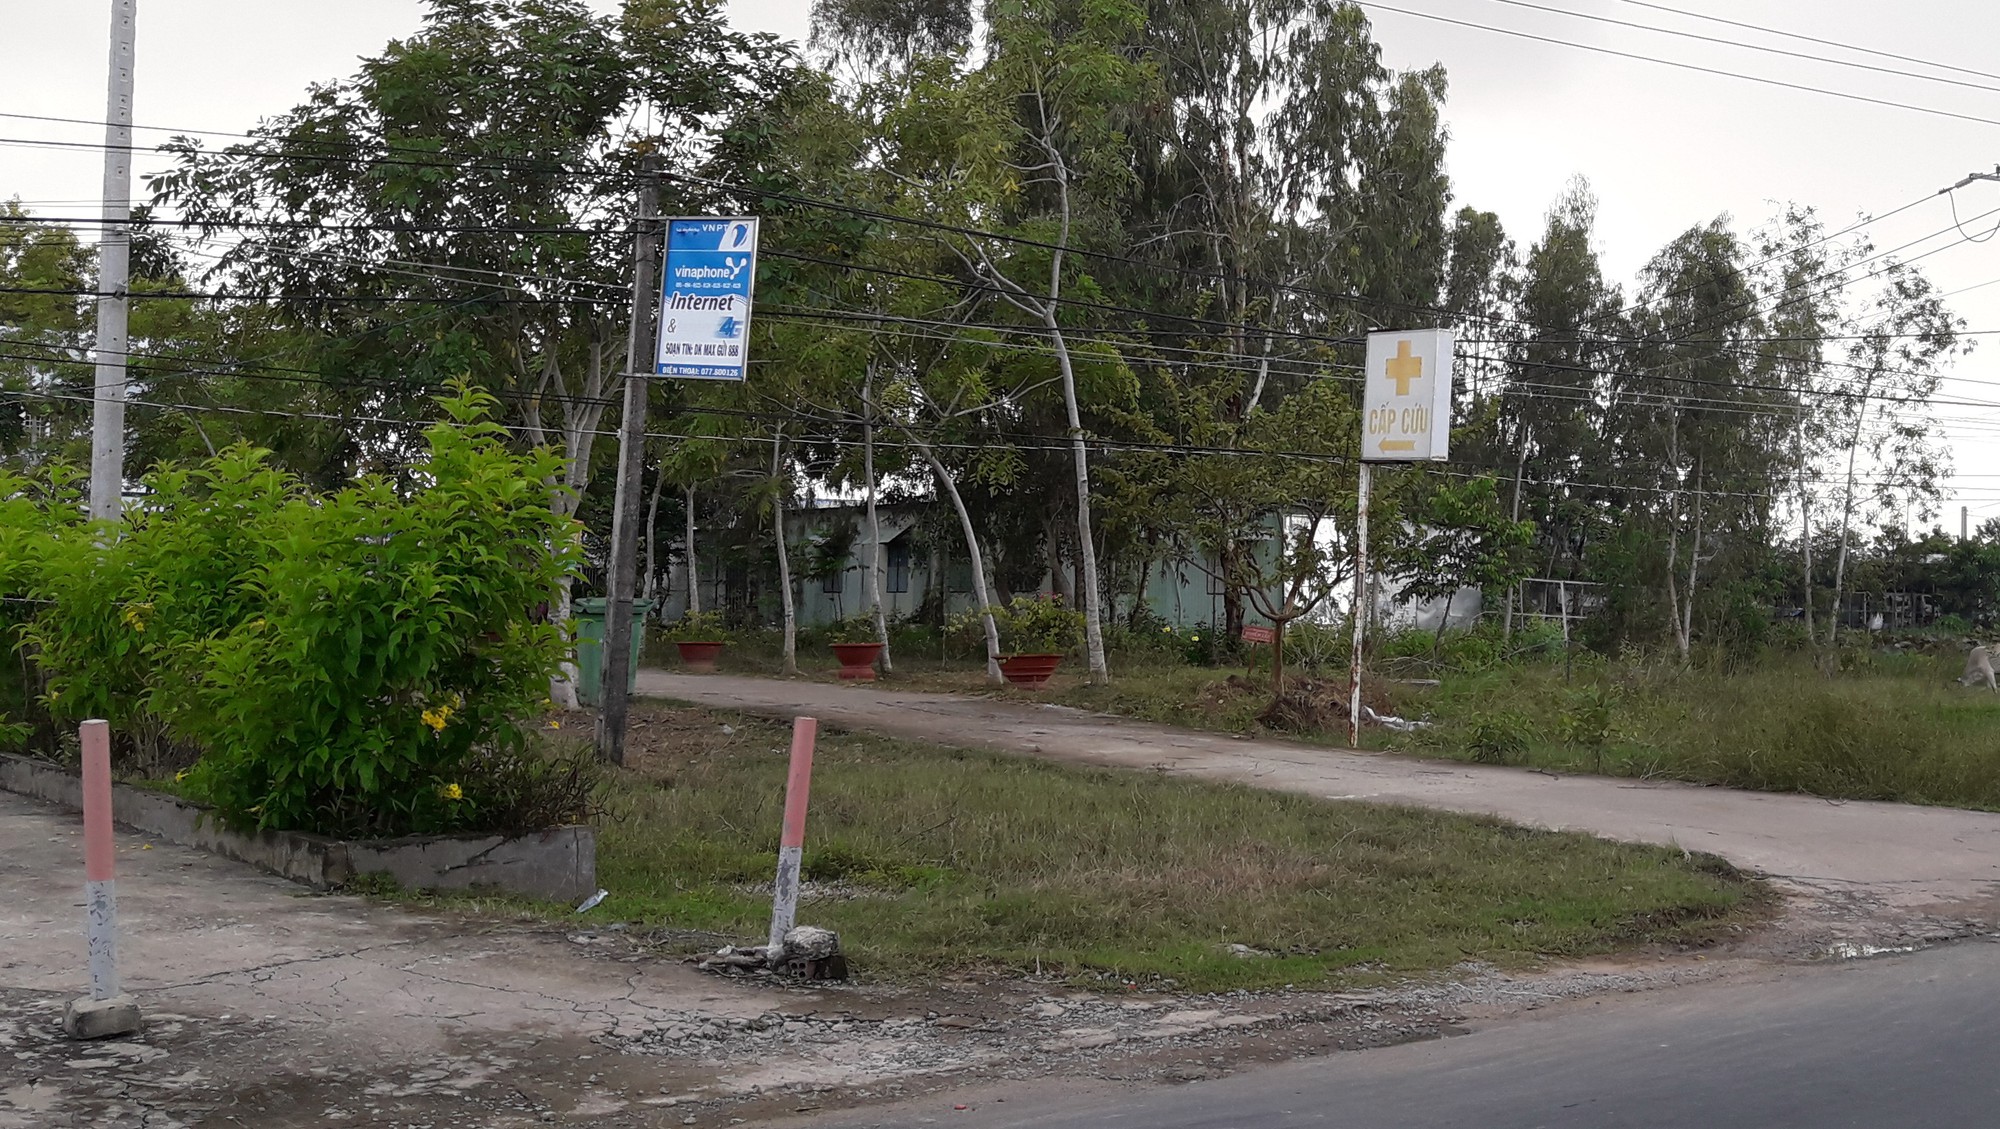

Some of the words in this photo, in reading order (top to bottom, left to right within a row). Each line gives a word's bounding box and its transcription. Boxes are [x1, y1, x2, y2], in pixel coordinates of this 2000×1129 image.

[702, 224, 728, 232] VNPT
[675, 265, 730, 279] vinaphone
[670, 293, 734, 310] Internet
[667, 318, 676, 333] &
[703, 344, 716, 356] MAX
[1369, 402, 1396, 434] CẤP
[1401, 402, 1429, 434] CỨU
